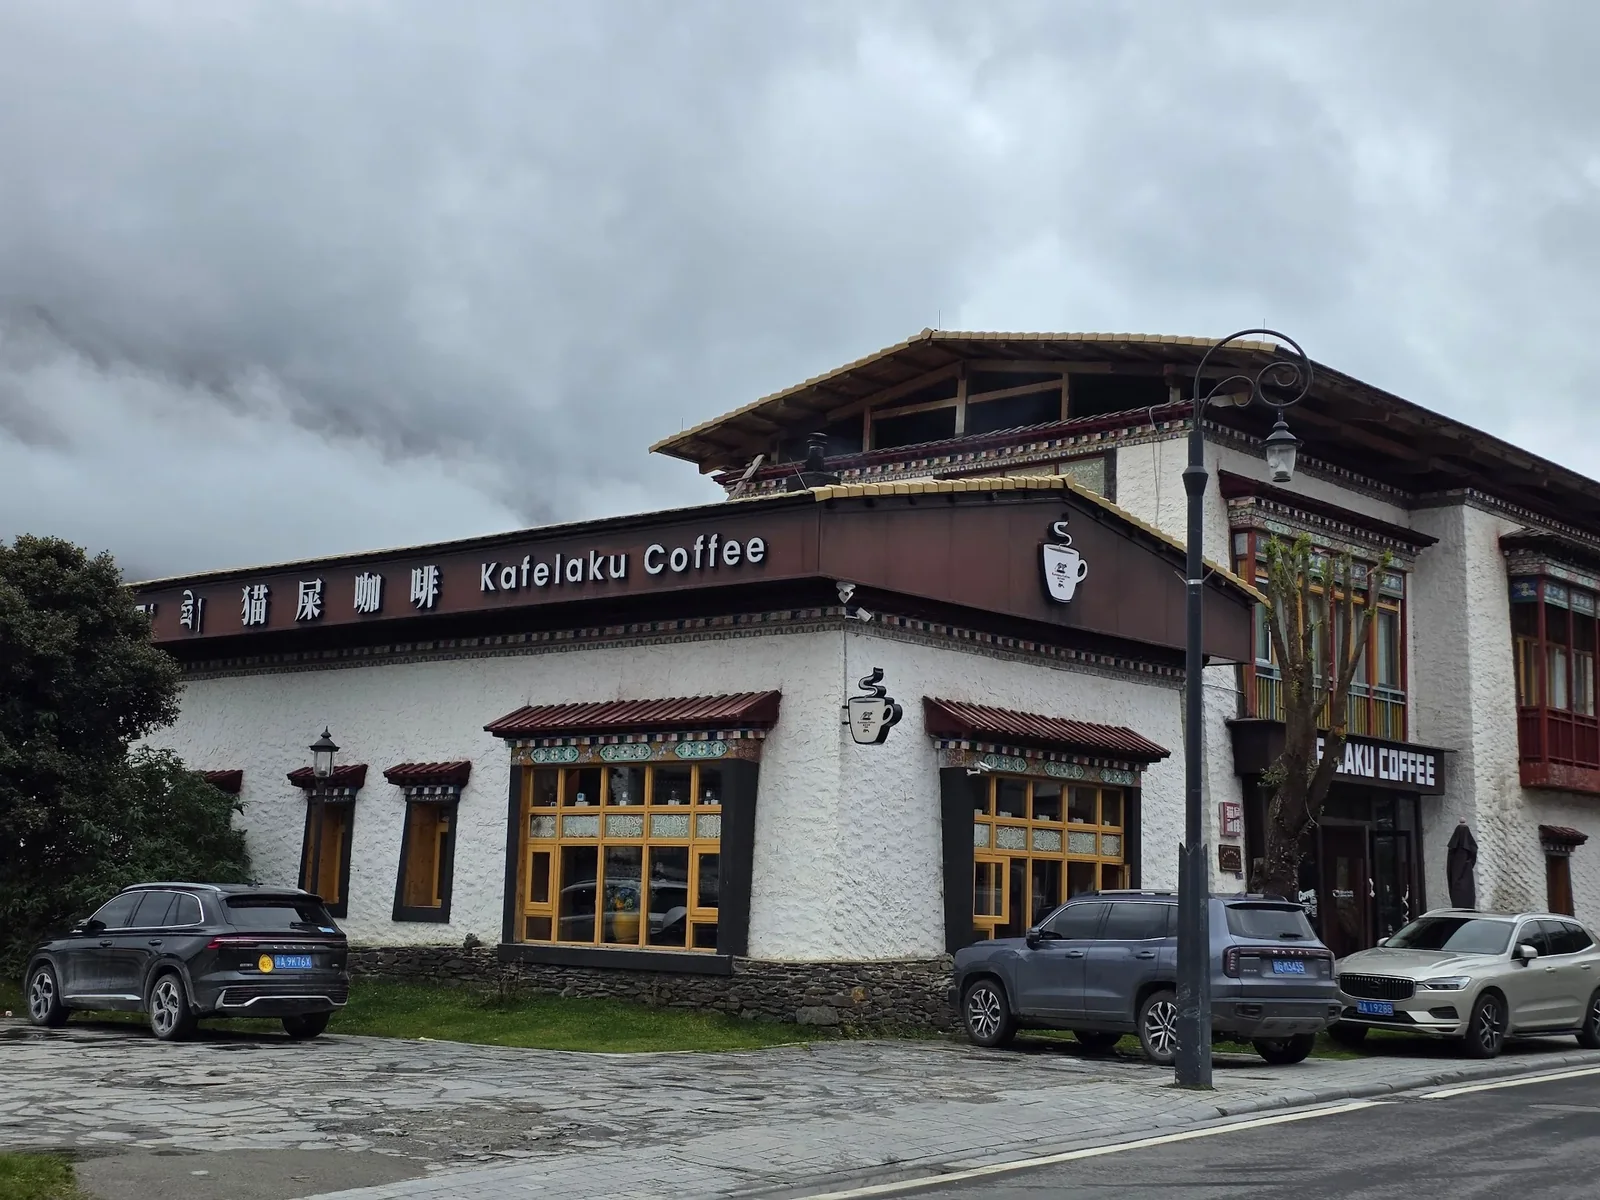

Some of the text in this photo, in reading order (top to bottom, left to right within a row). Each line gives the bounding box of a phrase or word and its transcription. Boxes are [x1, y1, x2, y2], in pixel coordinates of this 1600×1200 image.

[480, 532, 766, 592] Kafelaku Coffee
[240, 564, 439, 626] 猫屎咖啡
[1379, 747, 1436, 787] COFFEE
